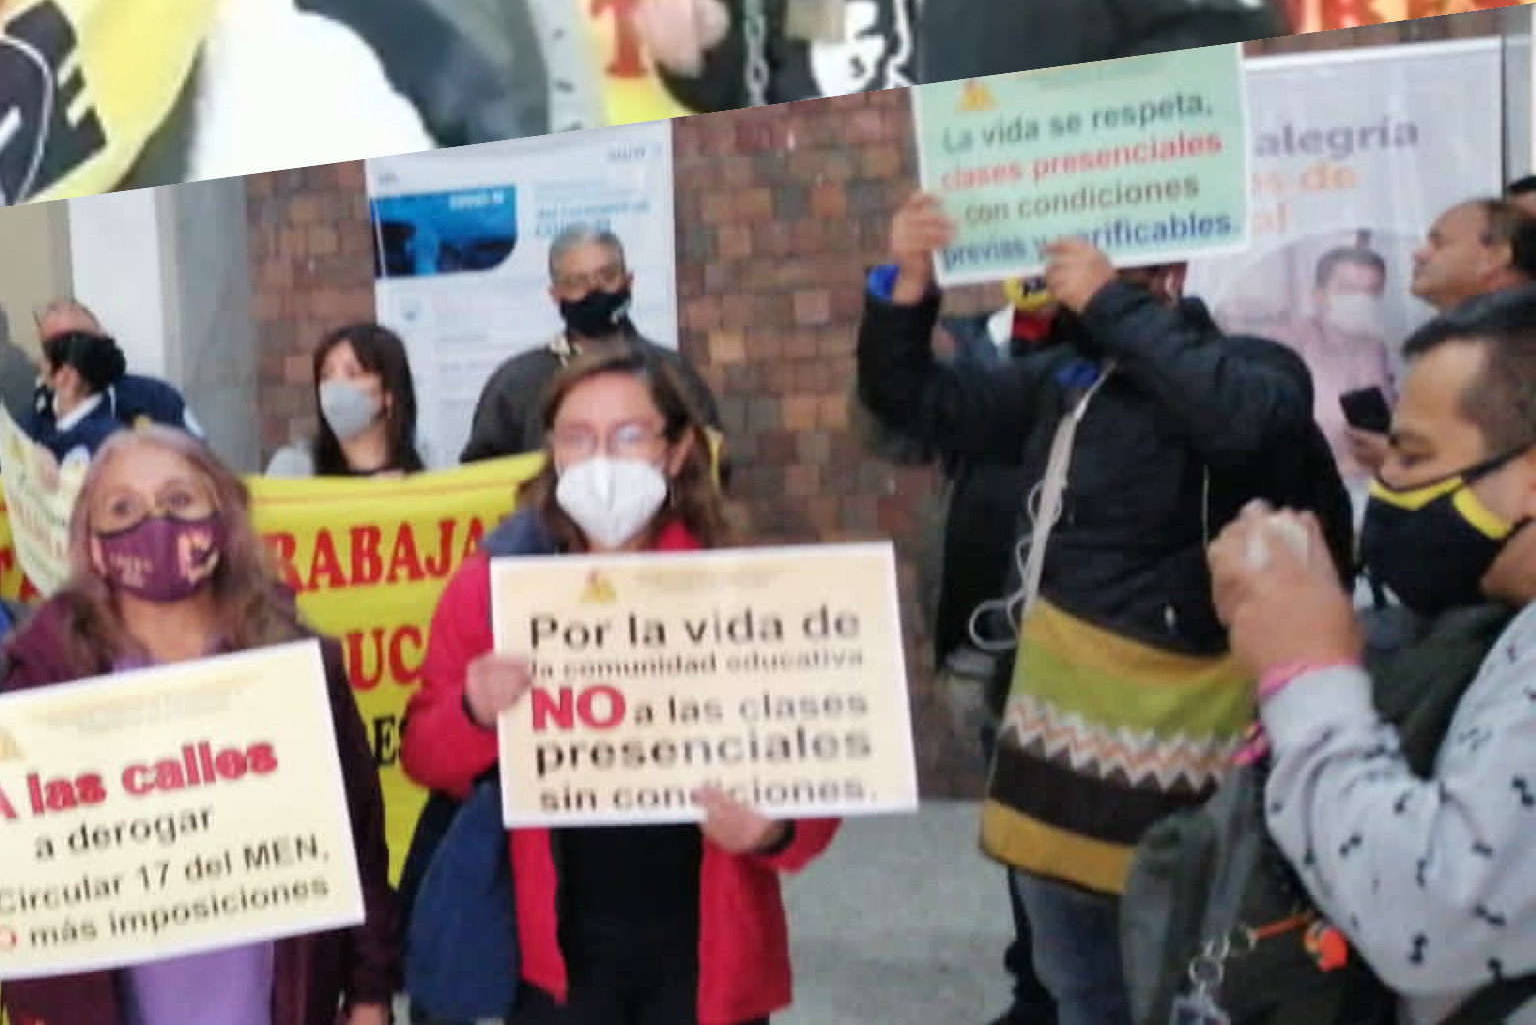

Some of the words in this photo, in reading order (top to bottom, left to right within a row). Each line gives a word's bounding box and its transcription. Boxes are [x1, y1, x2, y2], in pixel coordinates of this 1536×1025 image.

[943, 131, 973, 154] La
[981, 115, 1040, 145] vida
[1050, 113, 1082, 137] se
[1253, 115, 1419, 159] alegría
[942, 160, 1023, 189] clases
[1033, 130, 1223, 181] presenciales
[965, 200, 1009, 224] con
[1018, 174, 1199, 220] condiciones
[1066, 211, 1231, 251] rificables
[531, 613, 612, 651] Por
[628, 611, 666, 649] la
[683, 605, 785, 644] vida
[802, 602, 862, 641] de
[563, 653, 717, 678] comunidad
[725, 647, 863, 674] educativa
[531, 685, 627, 733] NO
[634, 699, 654, 726] a
[668, 693, 724, 726] las
[738, 691, 870, 724] clases
[536, 725, 872, 777] presenciales
[25, 771, 108, 818] las
[120, 739, 279, 797] calles
[540, 781, 598, 812] sin
[612, 777, 877, 811] conciones.
[34, 835, 55, 861] a
[66, 803, 215, 855] derogar
[139, 861, 170, 892] 17
[184, 847, 233, 883] del
[29, 918, 98, 948] más
[108, 875, 330, 936] imposiciones
